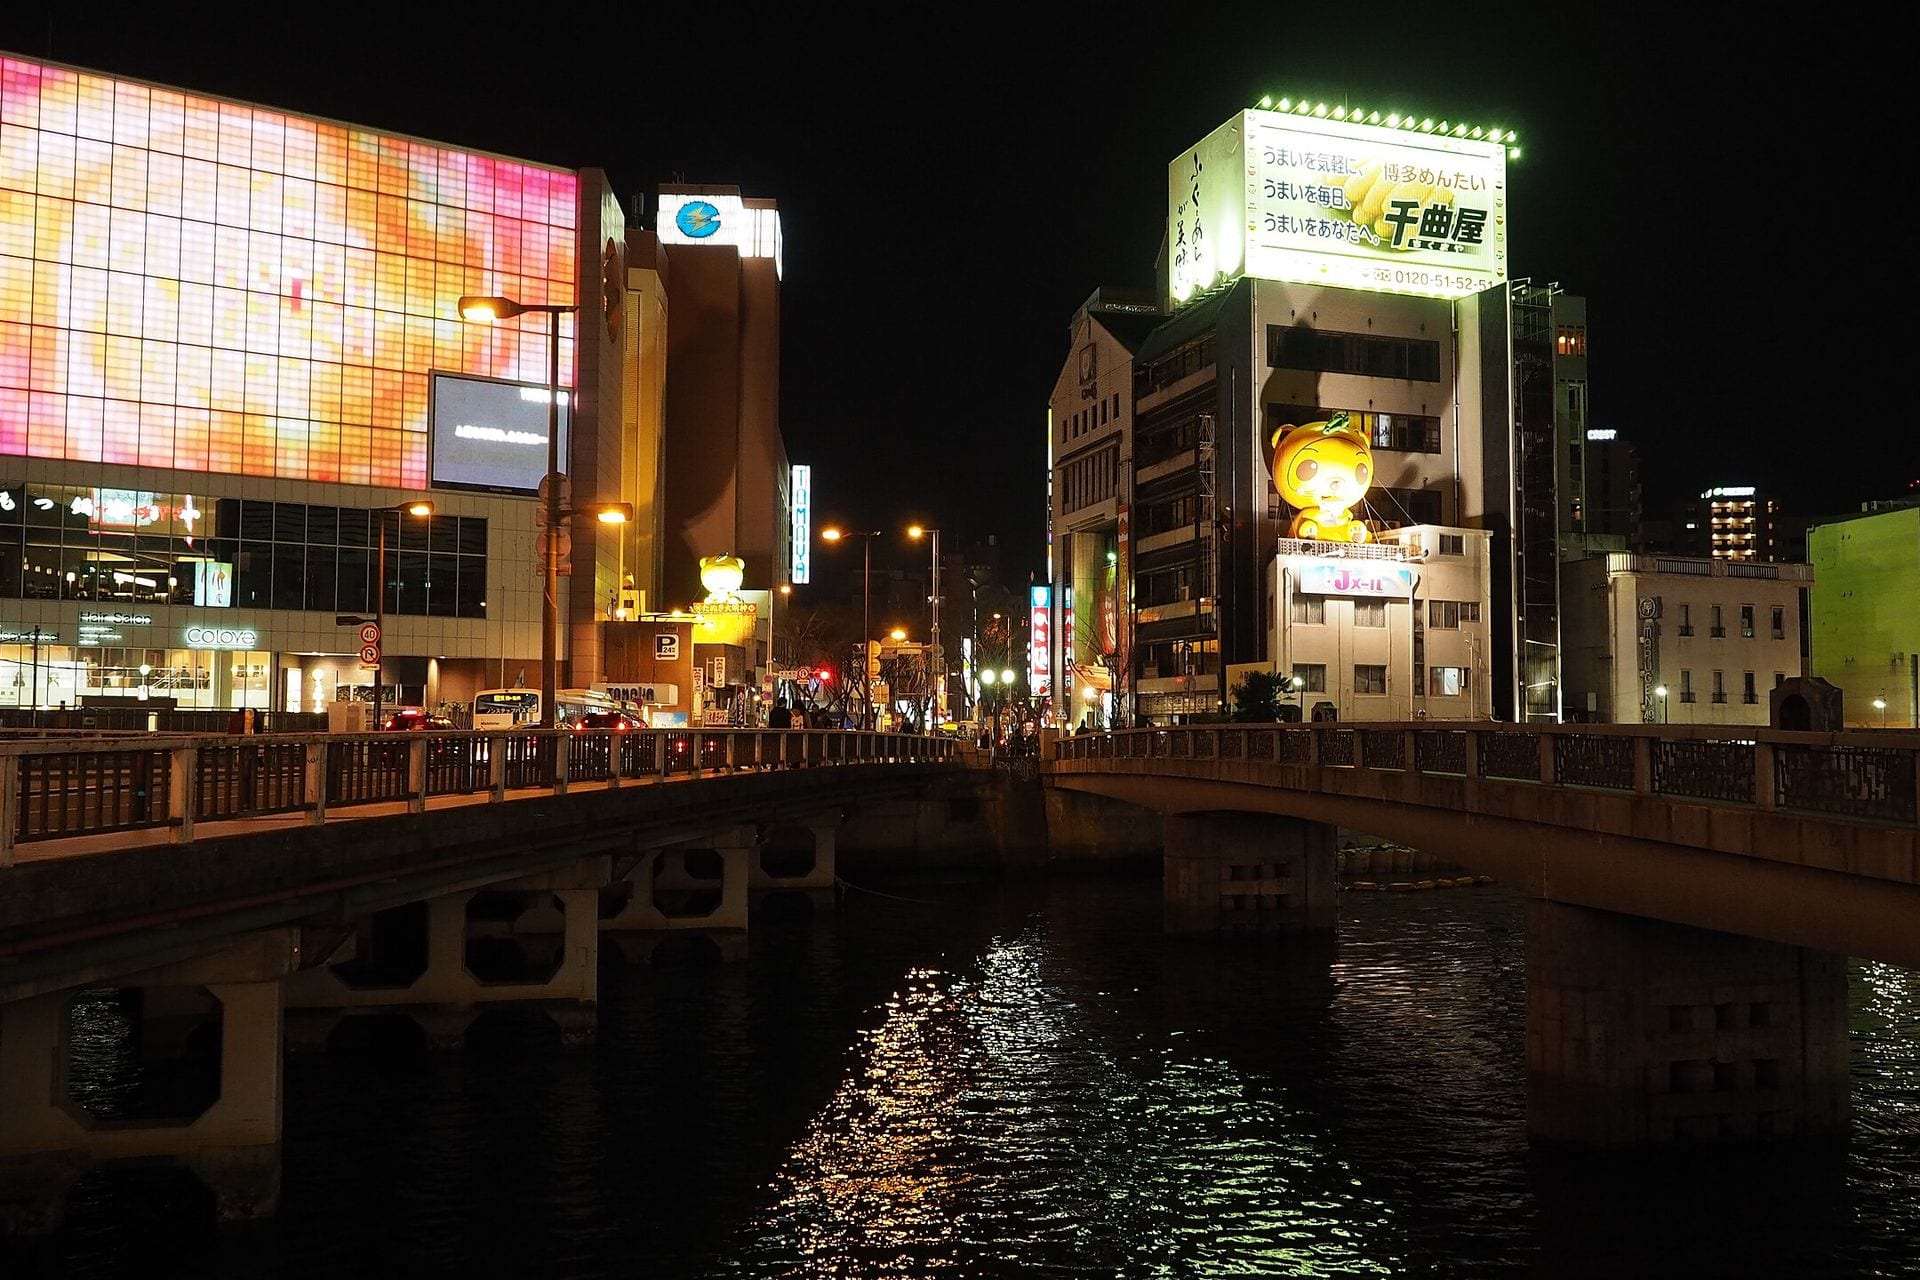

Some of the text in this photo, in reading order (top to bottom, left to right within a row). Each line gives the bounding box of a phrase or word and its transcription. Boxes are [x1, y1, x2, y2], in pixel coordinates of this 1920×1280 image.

[1263, 145, 1364, 177] うまいを気軽に、
[1384, 162, 1486, 191] 博多めんたい
[1264, 179, 1351, 208] うまいを毎日、
[1264, 212, 1380, 245] うまいをあなたへ。
[1385, 200, 1488, 246] 千曲屋
[1395, 270, 1493, 291] 0120-51-52-51
[1334, 570, 1383, 591] Jメール
[80, 611, 152, 625] Hair Salon
[364, 630, 375, 639] 40
[656, 636, 676, 653] P
